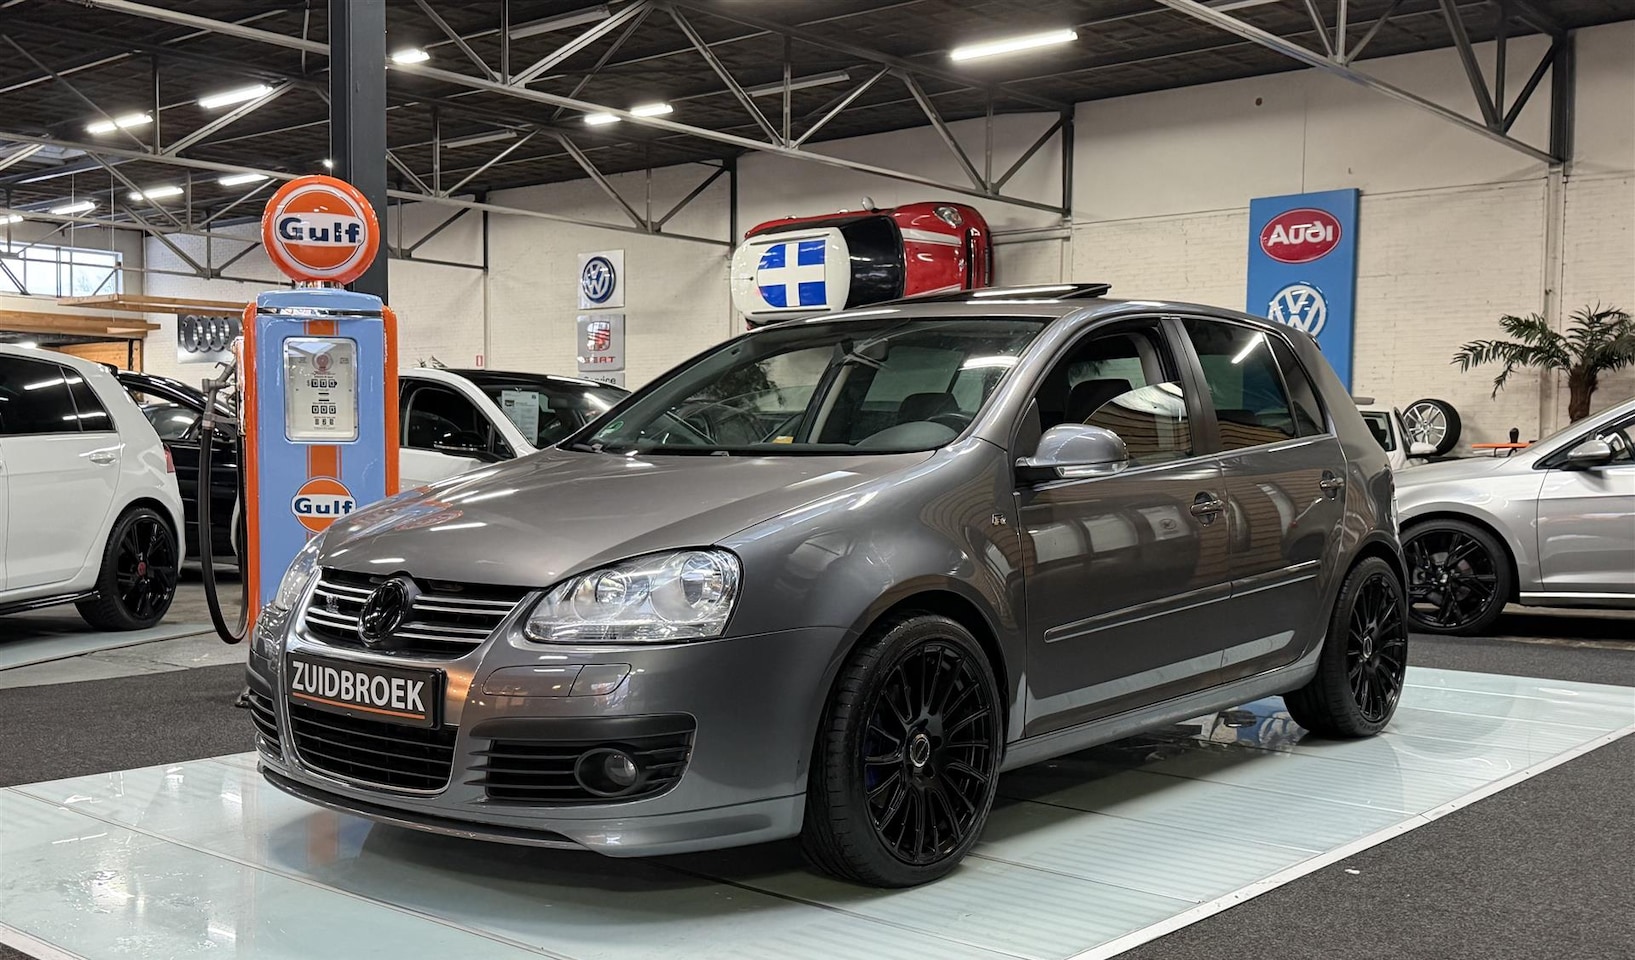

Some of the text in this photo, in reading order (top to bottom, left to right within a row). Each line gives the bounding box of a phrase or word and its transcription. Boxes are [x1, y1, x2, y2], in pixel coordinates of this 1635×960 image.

[279, 217, 360, 243] Gulf
[295, 498, 353, 514] Gulf
[292, 661, 425, 712] ZUIDBROEK
